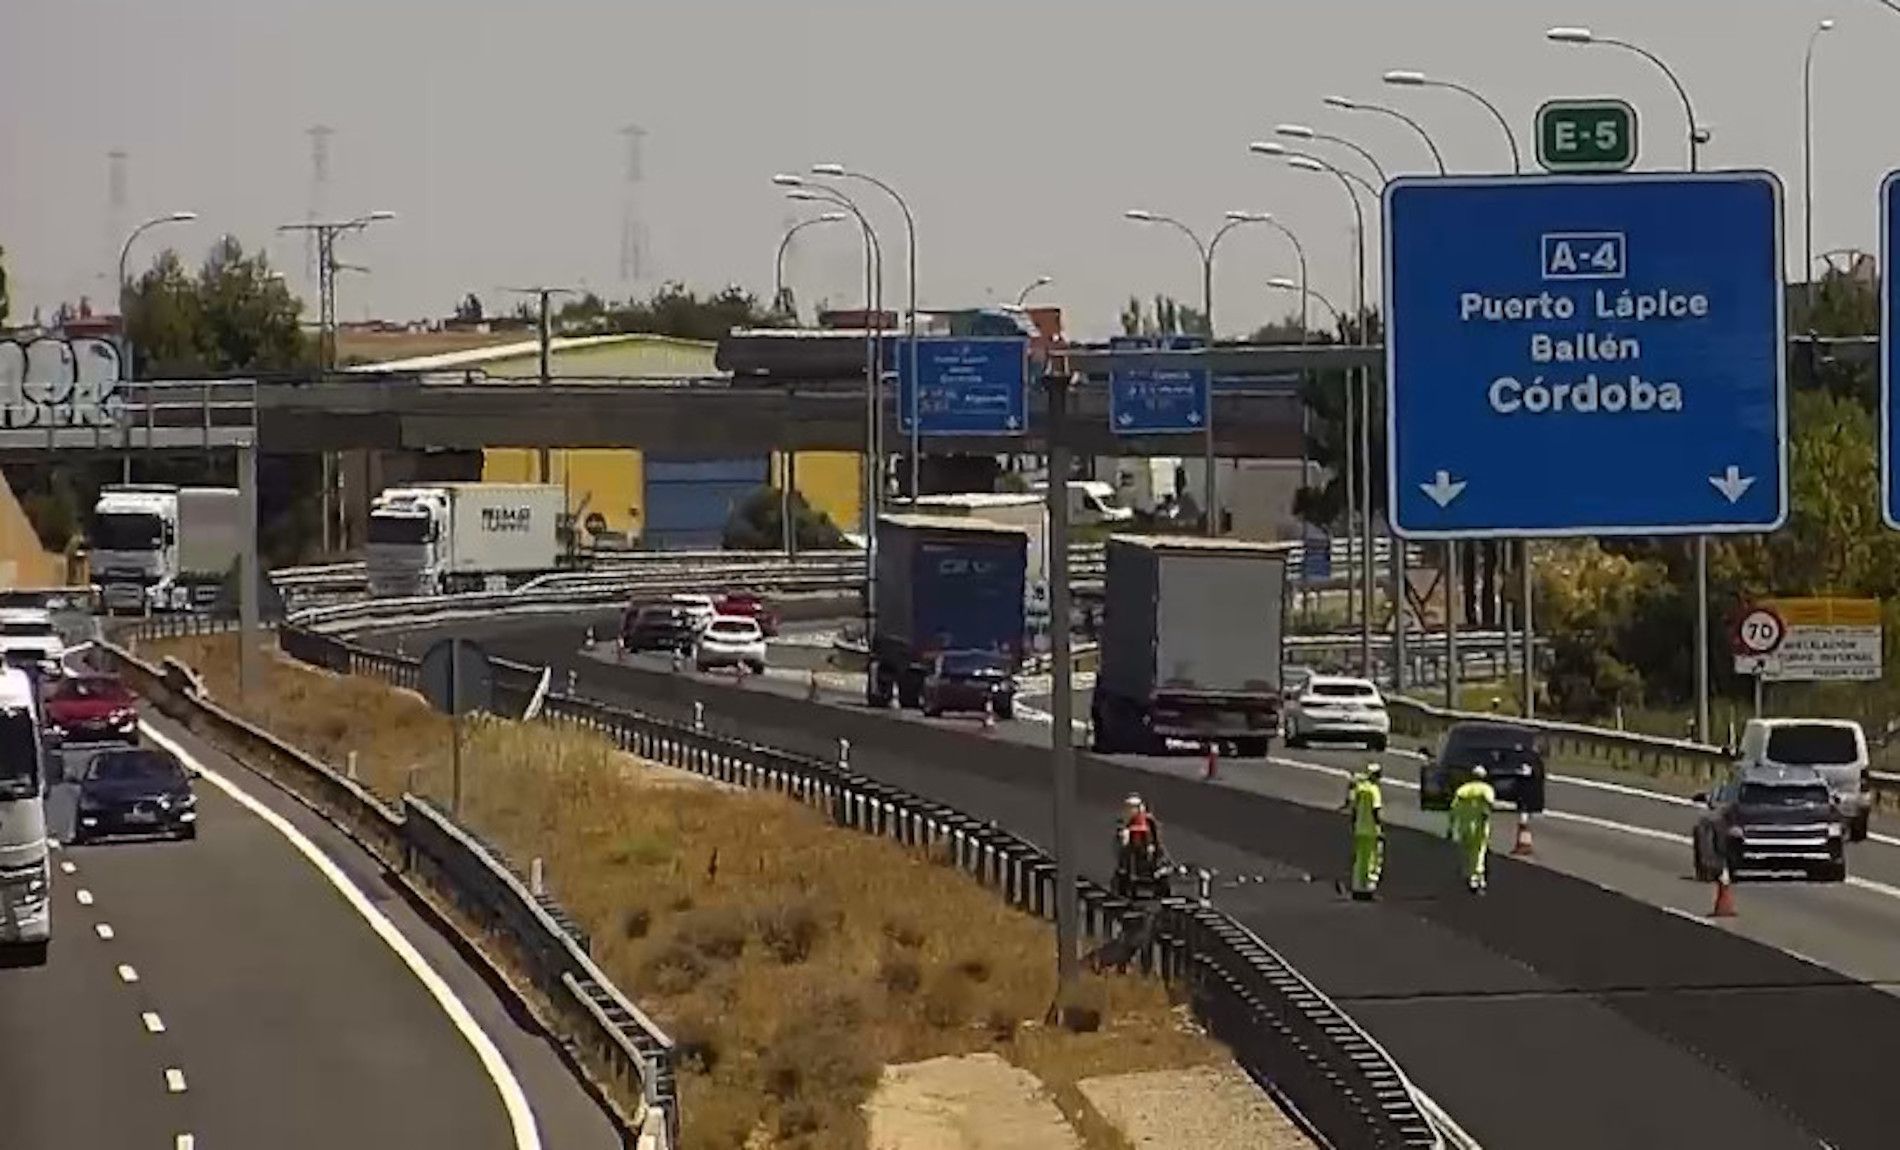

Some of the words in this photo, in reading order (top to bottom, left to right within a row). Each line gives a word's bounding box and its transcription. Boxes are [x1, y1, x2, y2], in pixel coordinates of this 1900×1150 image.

[1555, 121, 1617, 151] E-5
[1551, 241, 1616, 272] A-4
[1460, 291, 1574, 321] Puerto
[1488, 374, 1683, 413] Córdoba
[1749, 623, 1772, 640] 70
